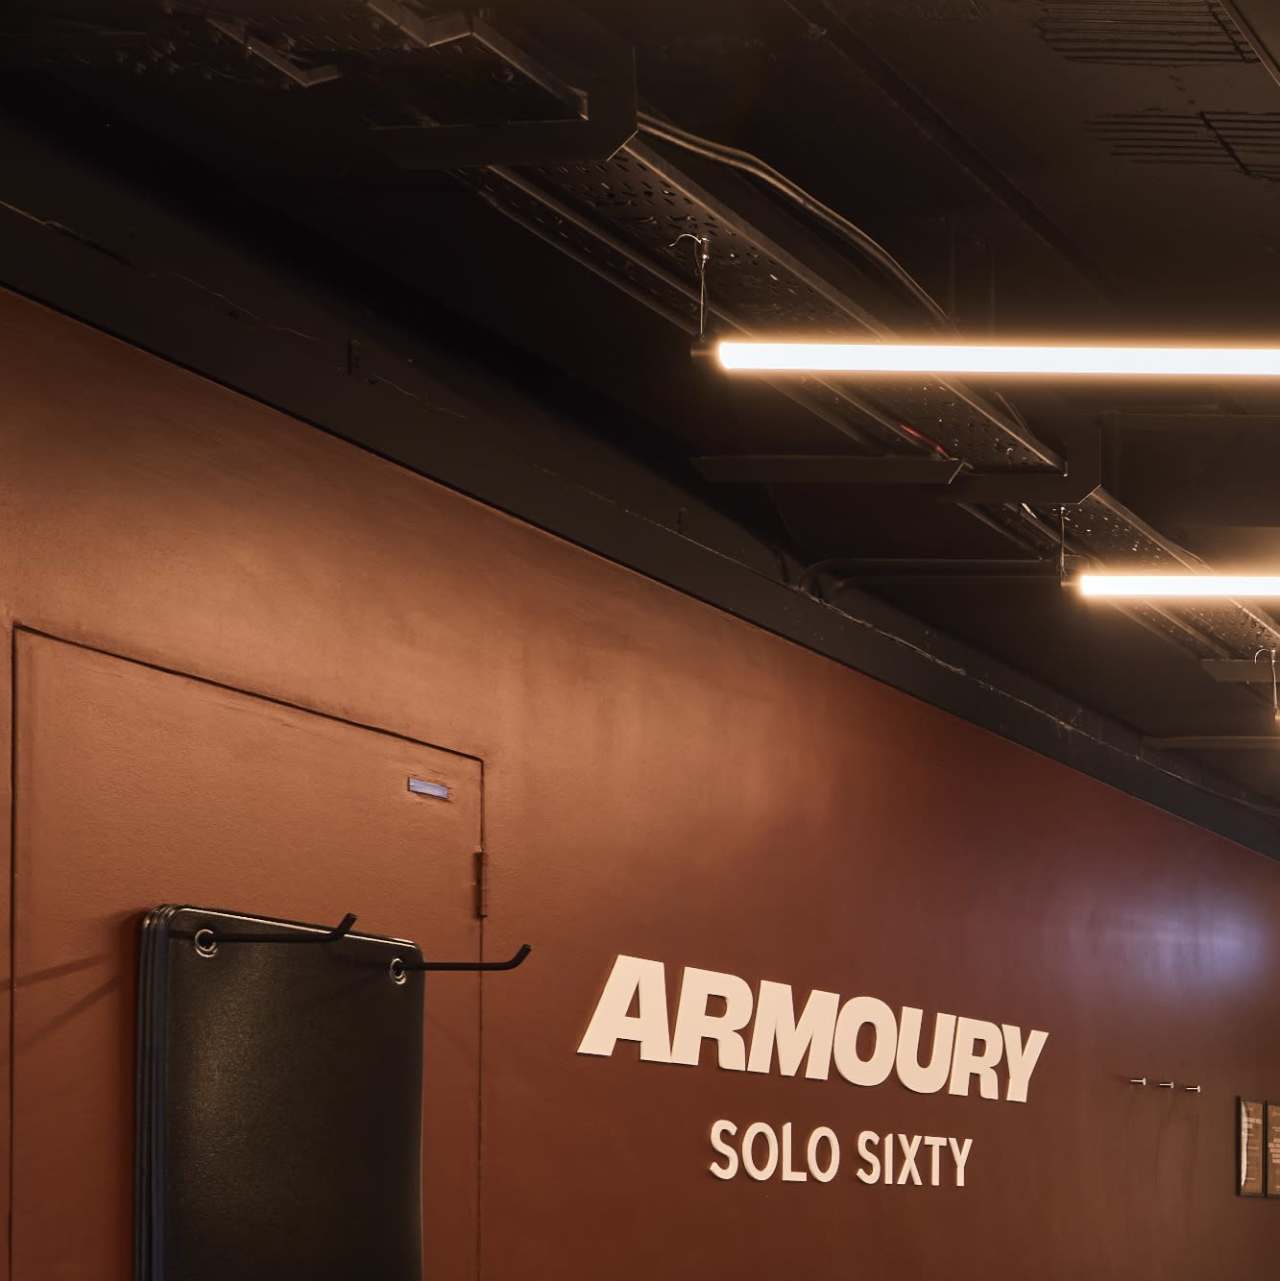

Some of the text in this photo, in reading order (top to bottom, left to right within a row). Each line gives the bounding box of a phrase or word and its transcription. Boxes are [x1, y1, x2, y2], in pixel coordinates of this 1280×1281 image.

[577, 954, 1050, 1103] ARMOURY
[709, 1119, 974, 1188] SOLO SIXTY
